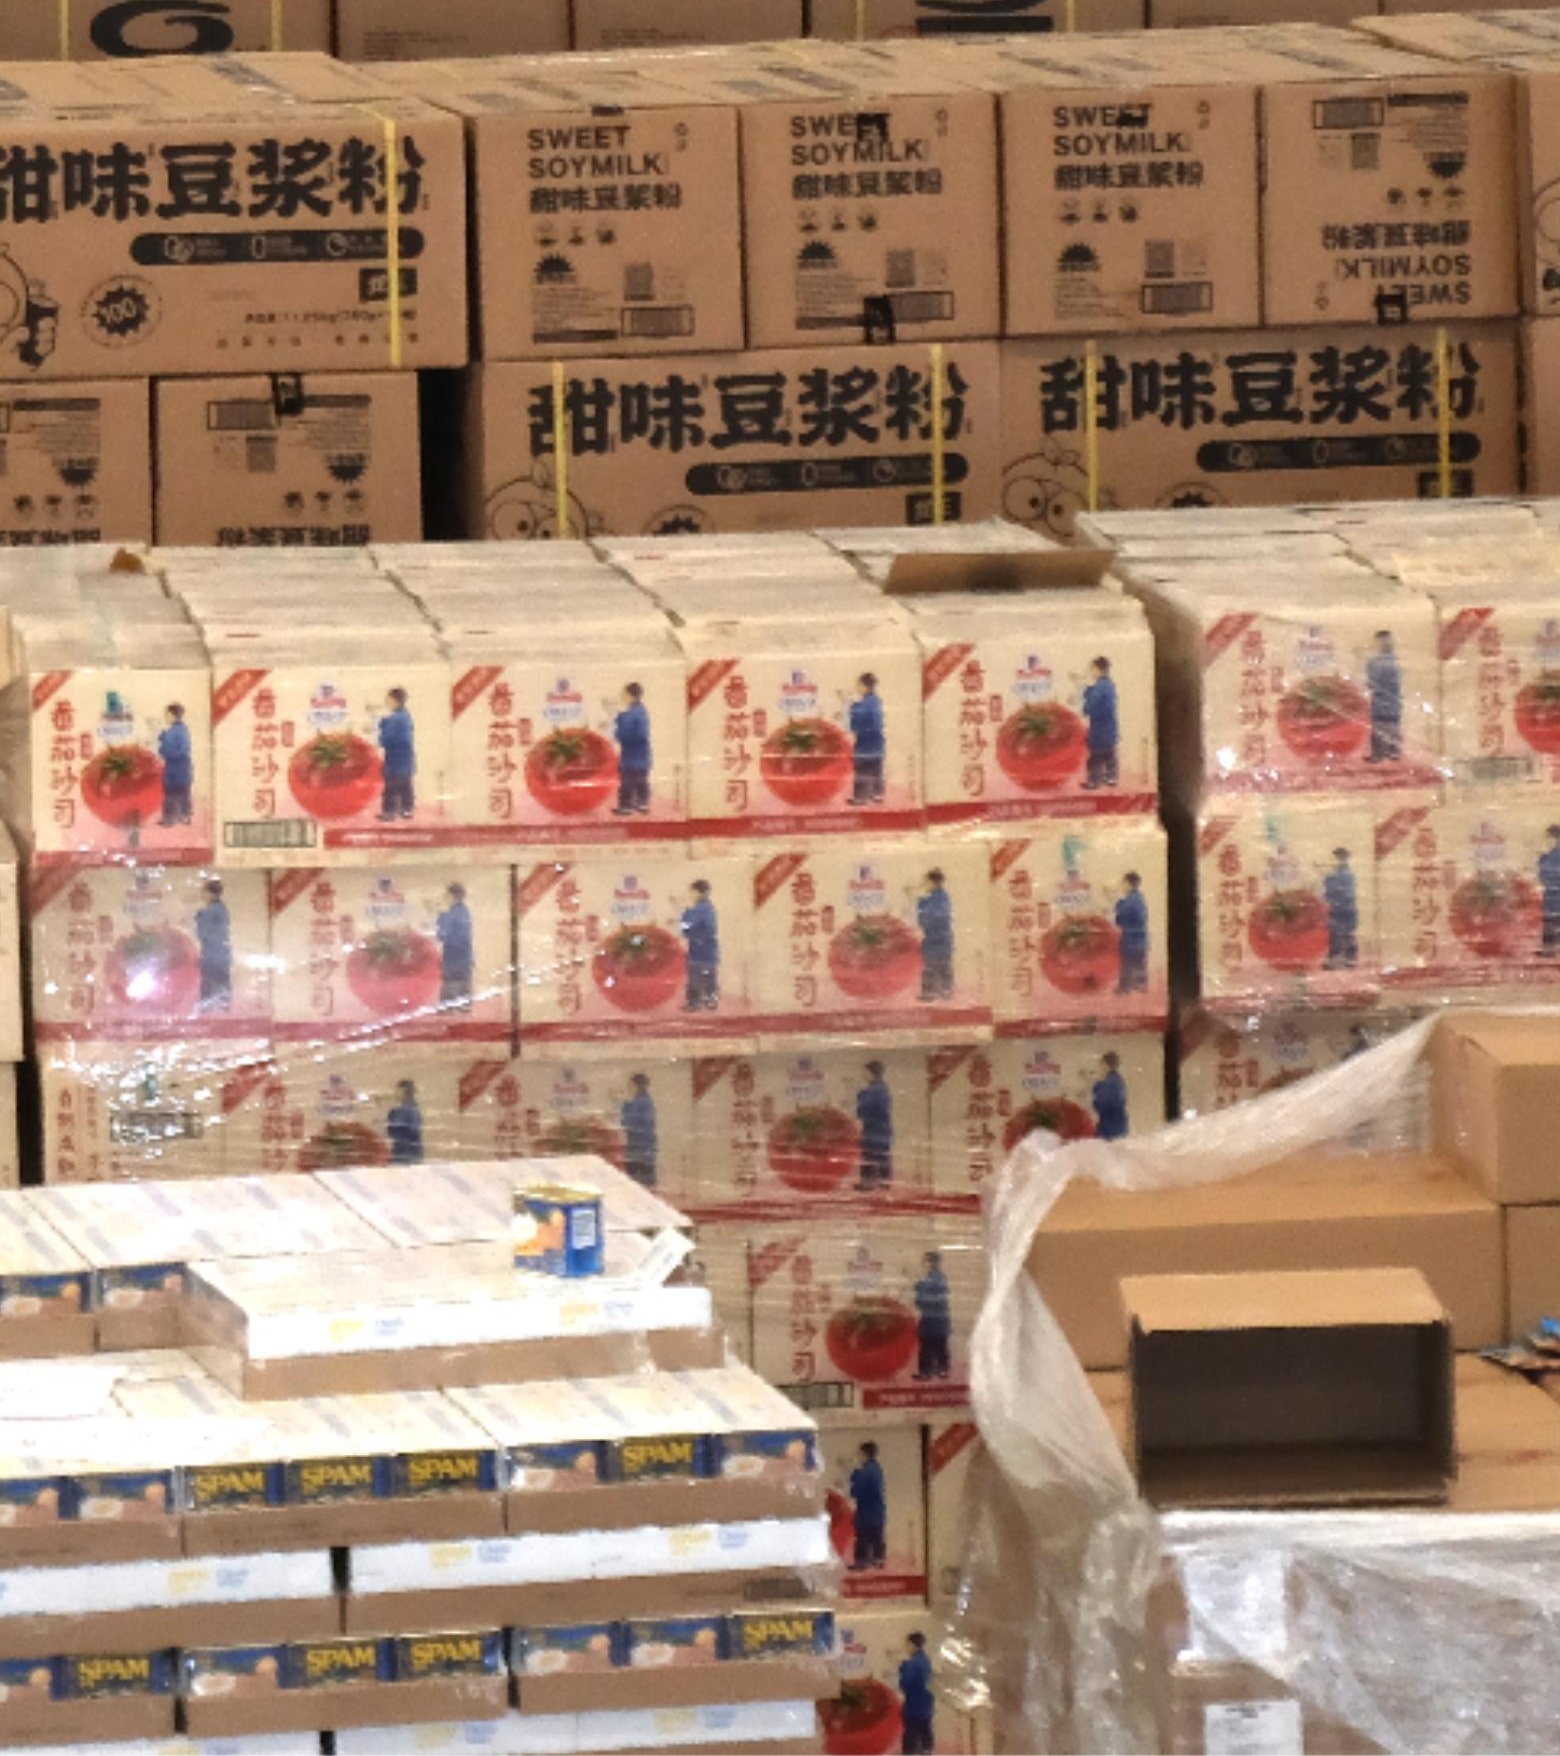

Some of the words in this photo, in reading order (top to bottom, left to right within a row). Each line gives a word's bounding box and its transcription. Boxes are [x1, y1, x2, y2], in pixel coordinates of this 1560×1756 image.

[528, 125, 631, 150] SWEET
[791, 139, 925, 167] SOYMILK
[1054, 131, 1189, 155] SOYMILK
[528, 152, 663, 179] SOYMILK
[1054, 161, 1203, 192] 甜味豆浆粉
[791, 168, 943, 199] 甜味豆浆粉
[529, 184, 682, 215] 甜味豆浆粉
[1322, 222, 1471, 253] 甜味豆浆粉
[1341, 254, 1471, 282] SOYMILK
[1039, 339, 1483, 435] 甜味豆浆粉
[526, 359, 969, 457] 甜味豆浆粉
[722, 673, 750, 812] 番茄沙司
[959, 660, 987, 797] 番茄沙司
[51, 697, 77, 829] 番茄沙司
[250, 687, 278, 819] 番茄沙司
[487, 681, 516, 818] 番茄沙司
[790, 873, 818, 1006] 番茄沙司
[407, 1452, 480, 1483] SPAM
[621, 1442, 693, 1471] SPAM
[192, 1466, 267, 1499] SPAM
[300, 1460, 372, 1492] SPAM
[744, 1615, 815, 1646] SPAM
[305, 1644, 379, 1676] SPAM
[410, 1635, 484, 1666] SPAM
[77, 1655, 152, 1686] SPAM
